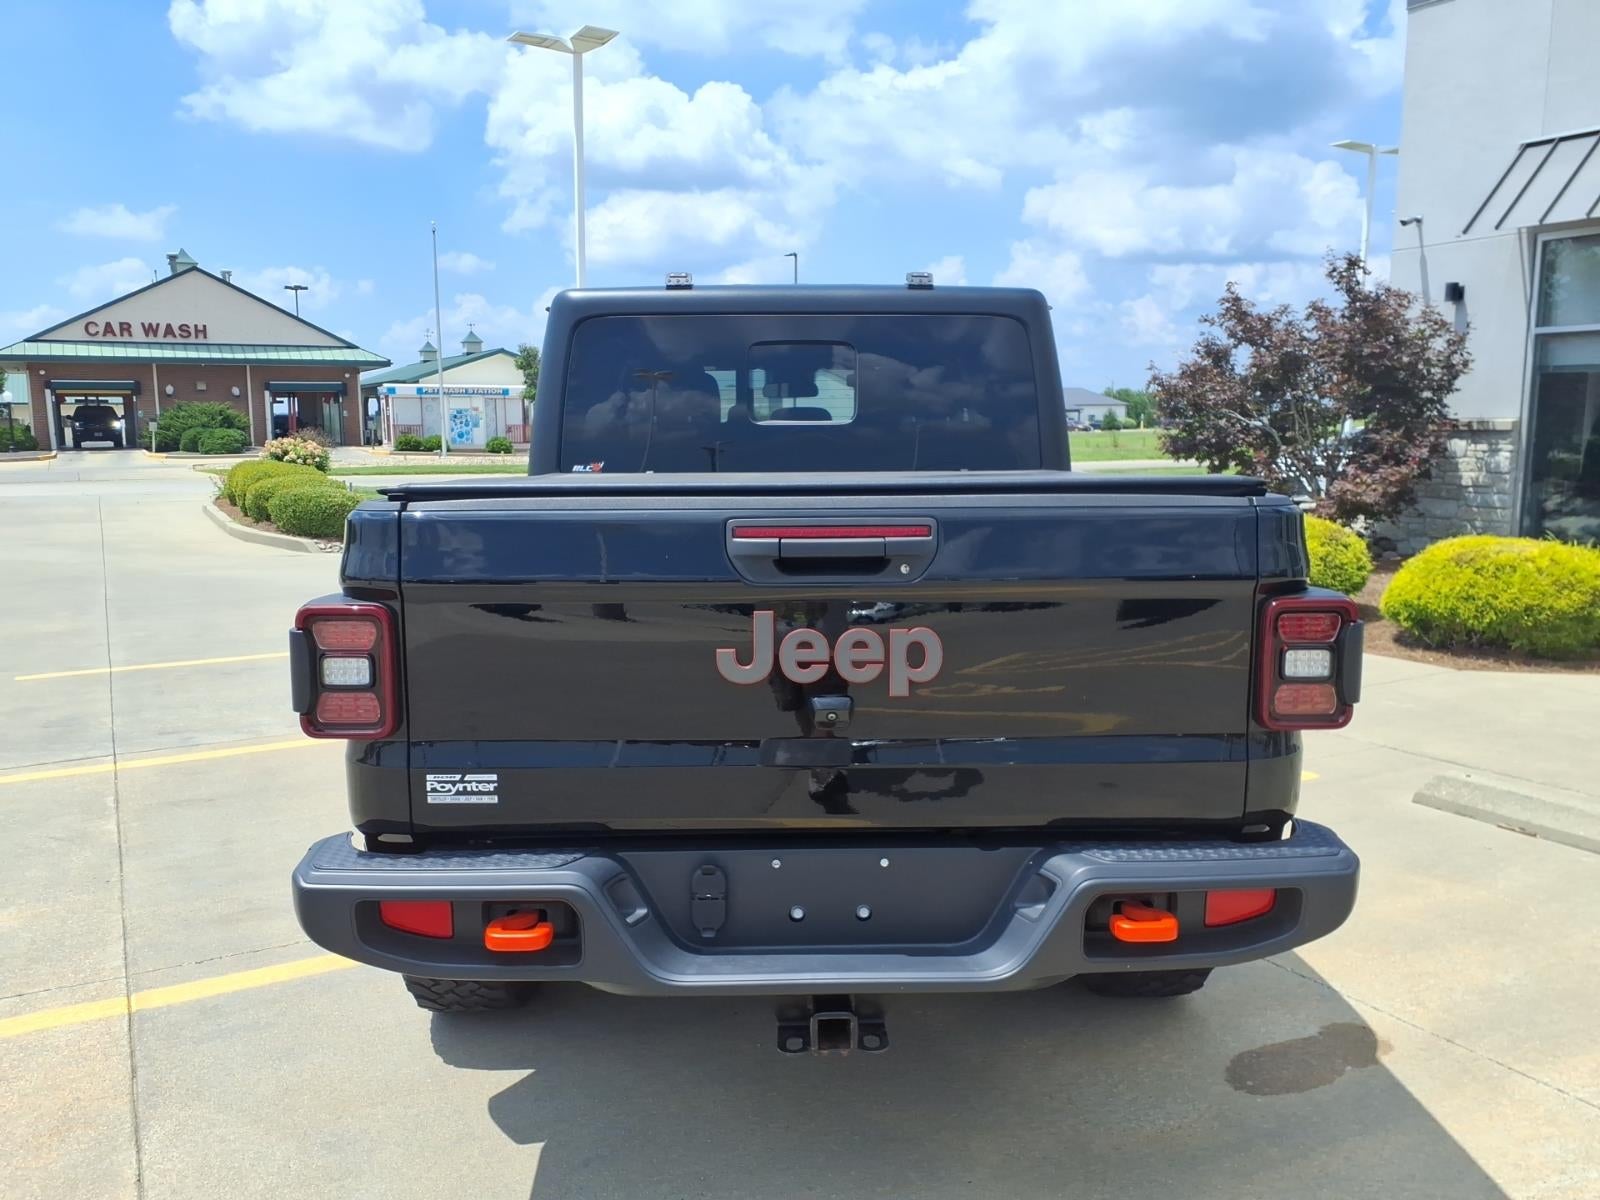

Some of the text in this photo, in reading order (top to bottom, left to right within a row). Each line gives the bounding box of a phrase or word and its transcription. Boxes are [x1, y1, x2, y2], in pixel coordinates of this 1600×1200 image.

[84, 321, 208, 339] CAR WASH
[422, 387, 503, 397] PET WASH STATION
[715, 610, 944, 697] Jeep
[426, 781, 498, 796] Poynter
